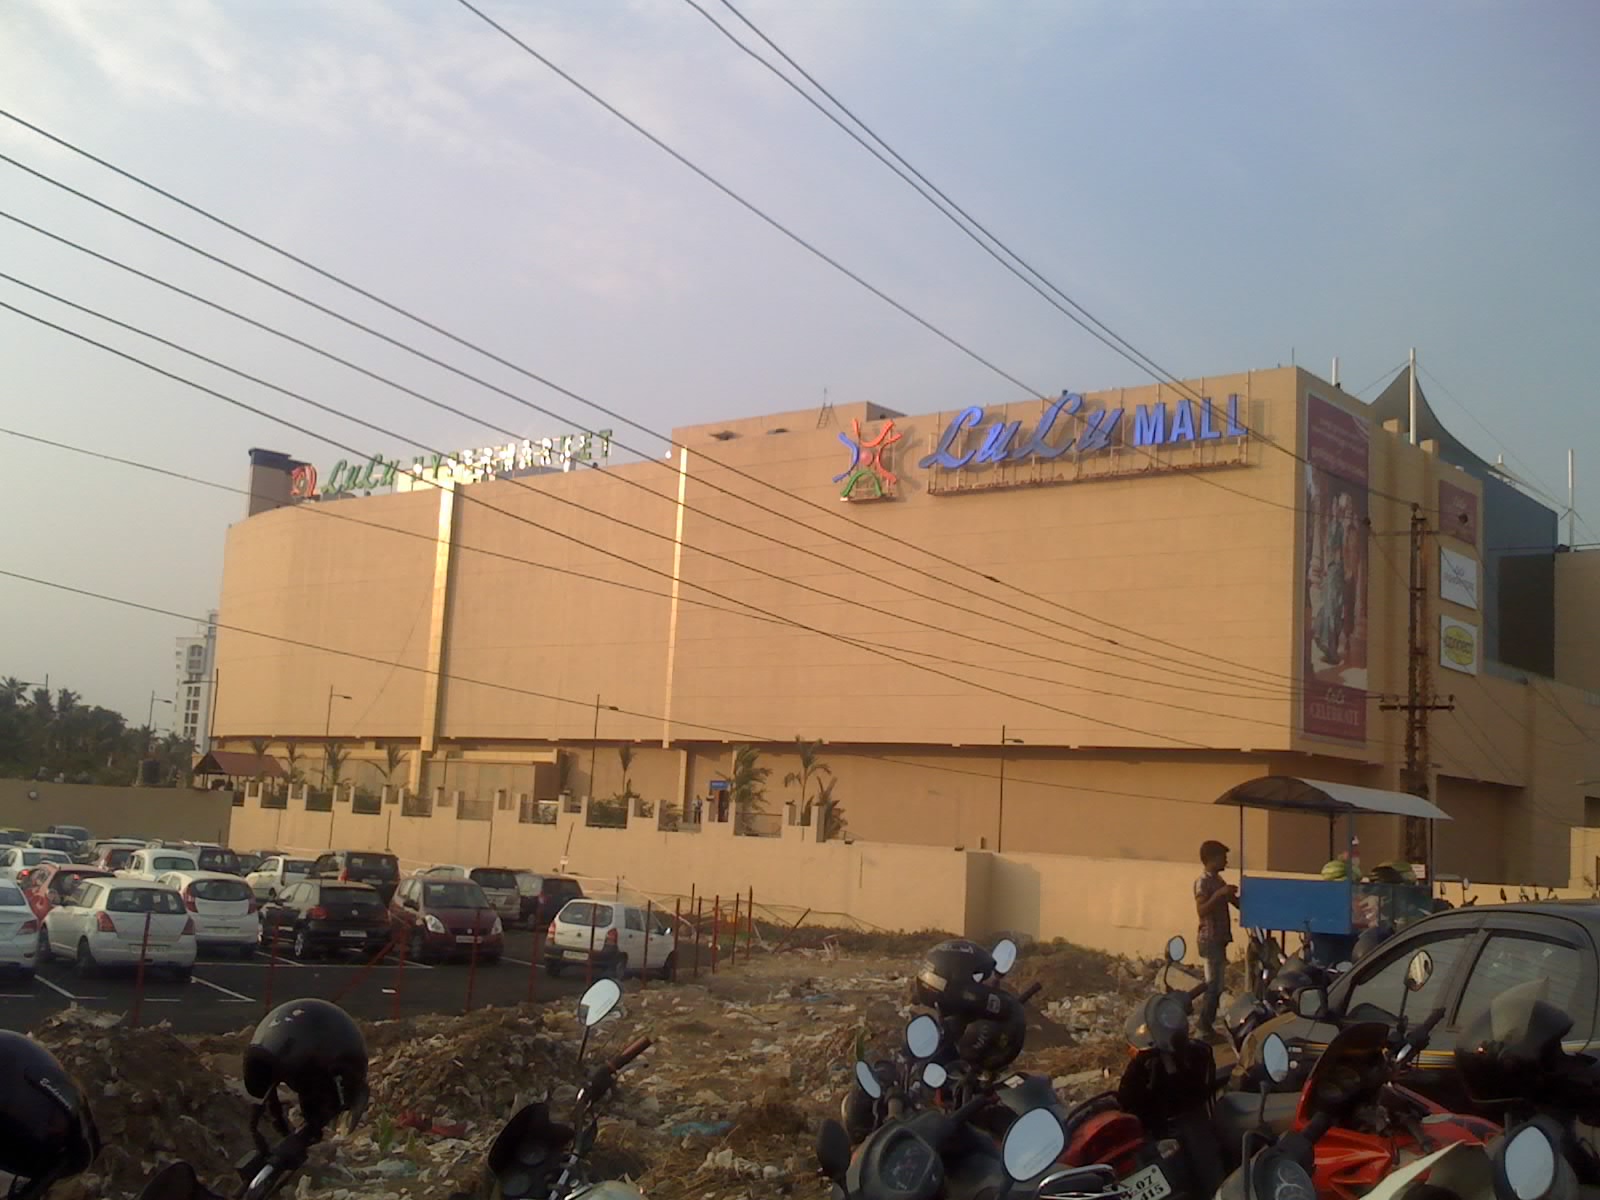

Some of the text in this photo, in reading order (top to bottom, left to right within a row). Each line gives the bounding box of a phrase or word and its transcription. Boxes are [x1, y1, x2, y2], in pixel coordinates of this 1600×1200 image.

[919, 393, 1125, 468] LuLu
[1133, 393, 1249, 446] MALL
[321, 453, 400, 494] LuLu
[1136, 1175, 1153, 1190] 07
